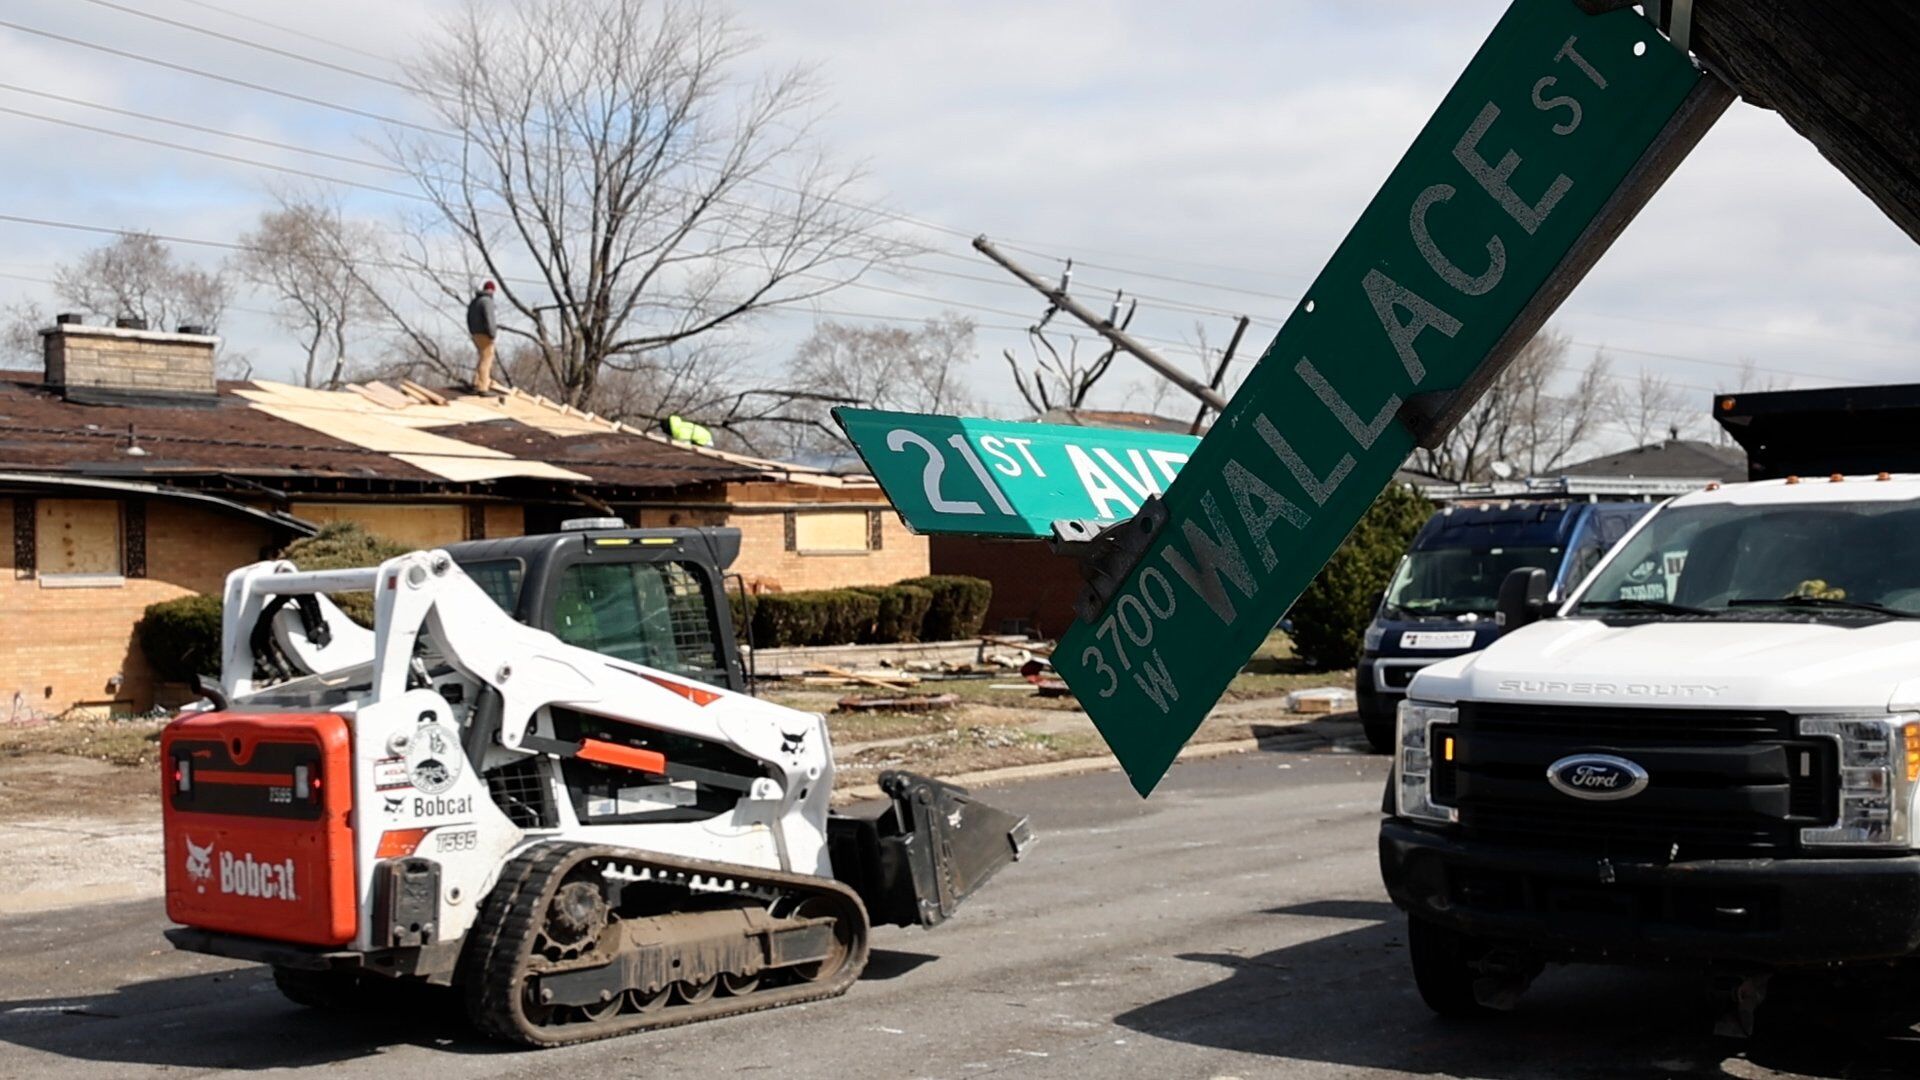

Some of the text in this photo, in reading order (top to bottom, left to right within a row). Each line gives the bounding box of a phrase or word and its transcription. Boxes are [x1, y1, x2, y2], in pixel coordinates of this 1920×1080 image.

[1161, 36, 1608, 626] WALLACE ST
[1082, 566, 1176, 698] 3700
[1133, 647, 1180, 714] W
[1498, 680, 1729, 697] SUPER DUTY
[1571, 765, 1620, 788] Ford
[414, 795, 473, 817] Bobcat
[436, 830, 478, 853] T595
[219, 851, 296, 900] Bobcat
